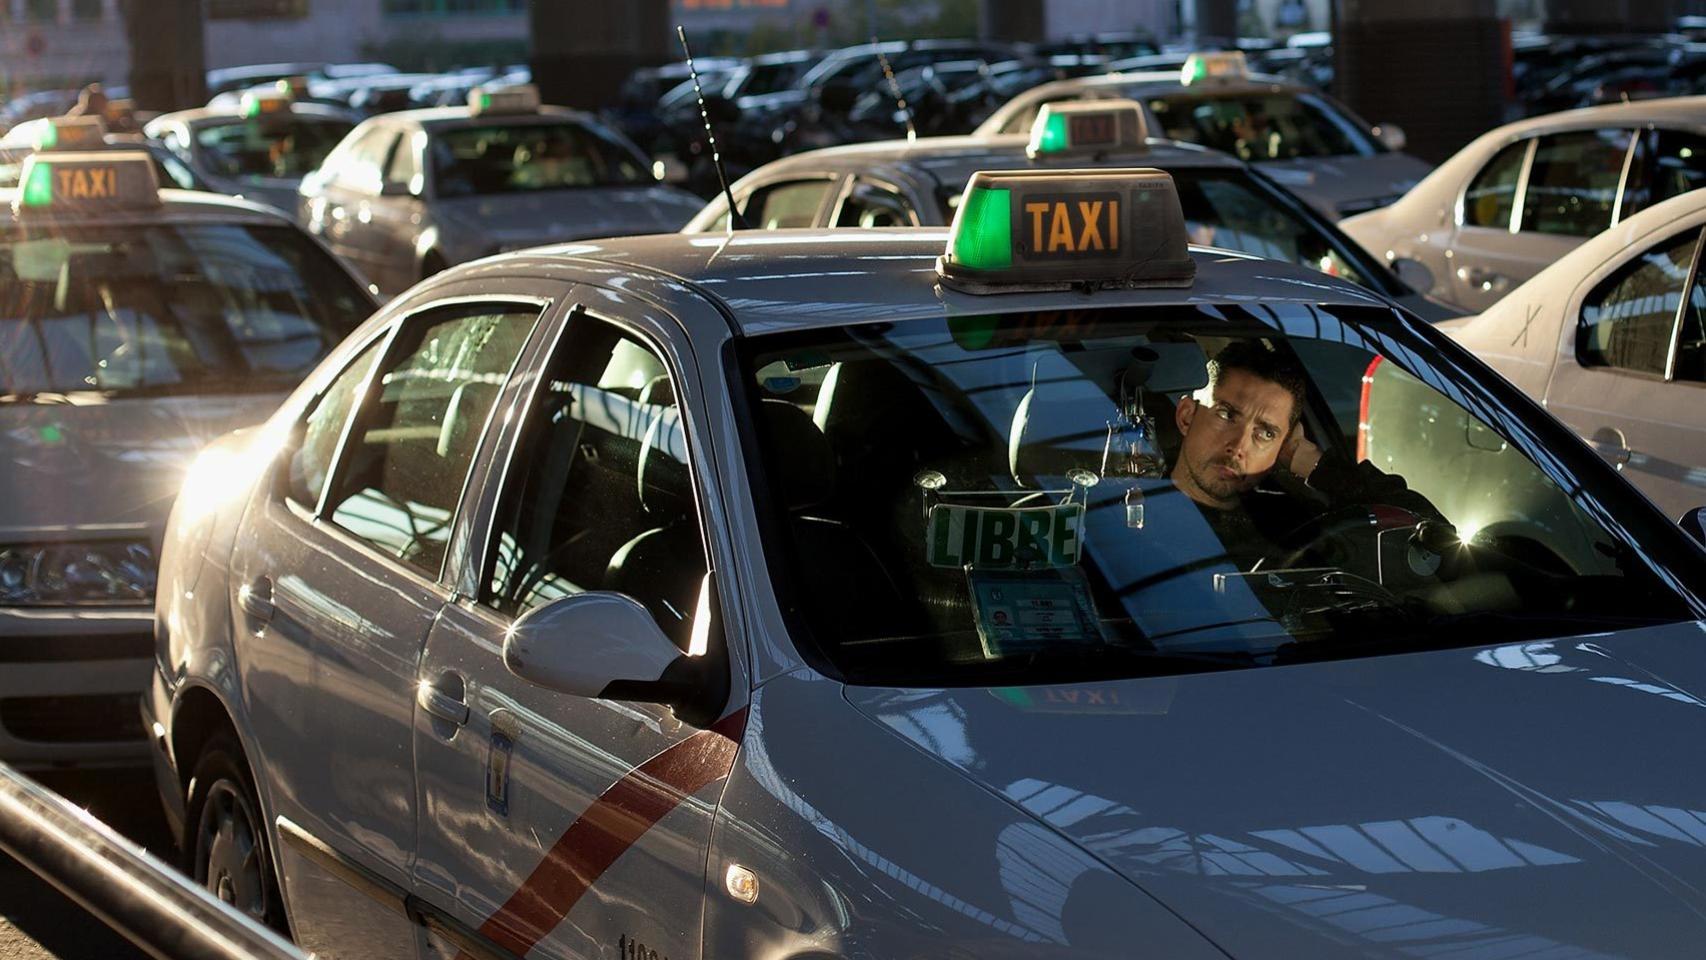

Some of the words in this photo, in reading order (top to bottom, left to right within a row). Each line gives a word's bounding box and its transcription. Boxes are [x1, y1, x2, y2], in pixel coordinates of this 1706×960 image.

[58, 167, 117, 198] TAXI
[1025, 201, 1118, 253] TAXI
[933, 505, 1078, 568] LIBRE
